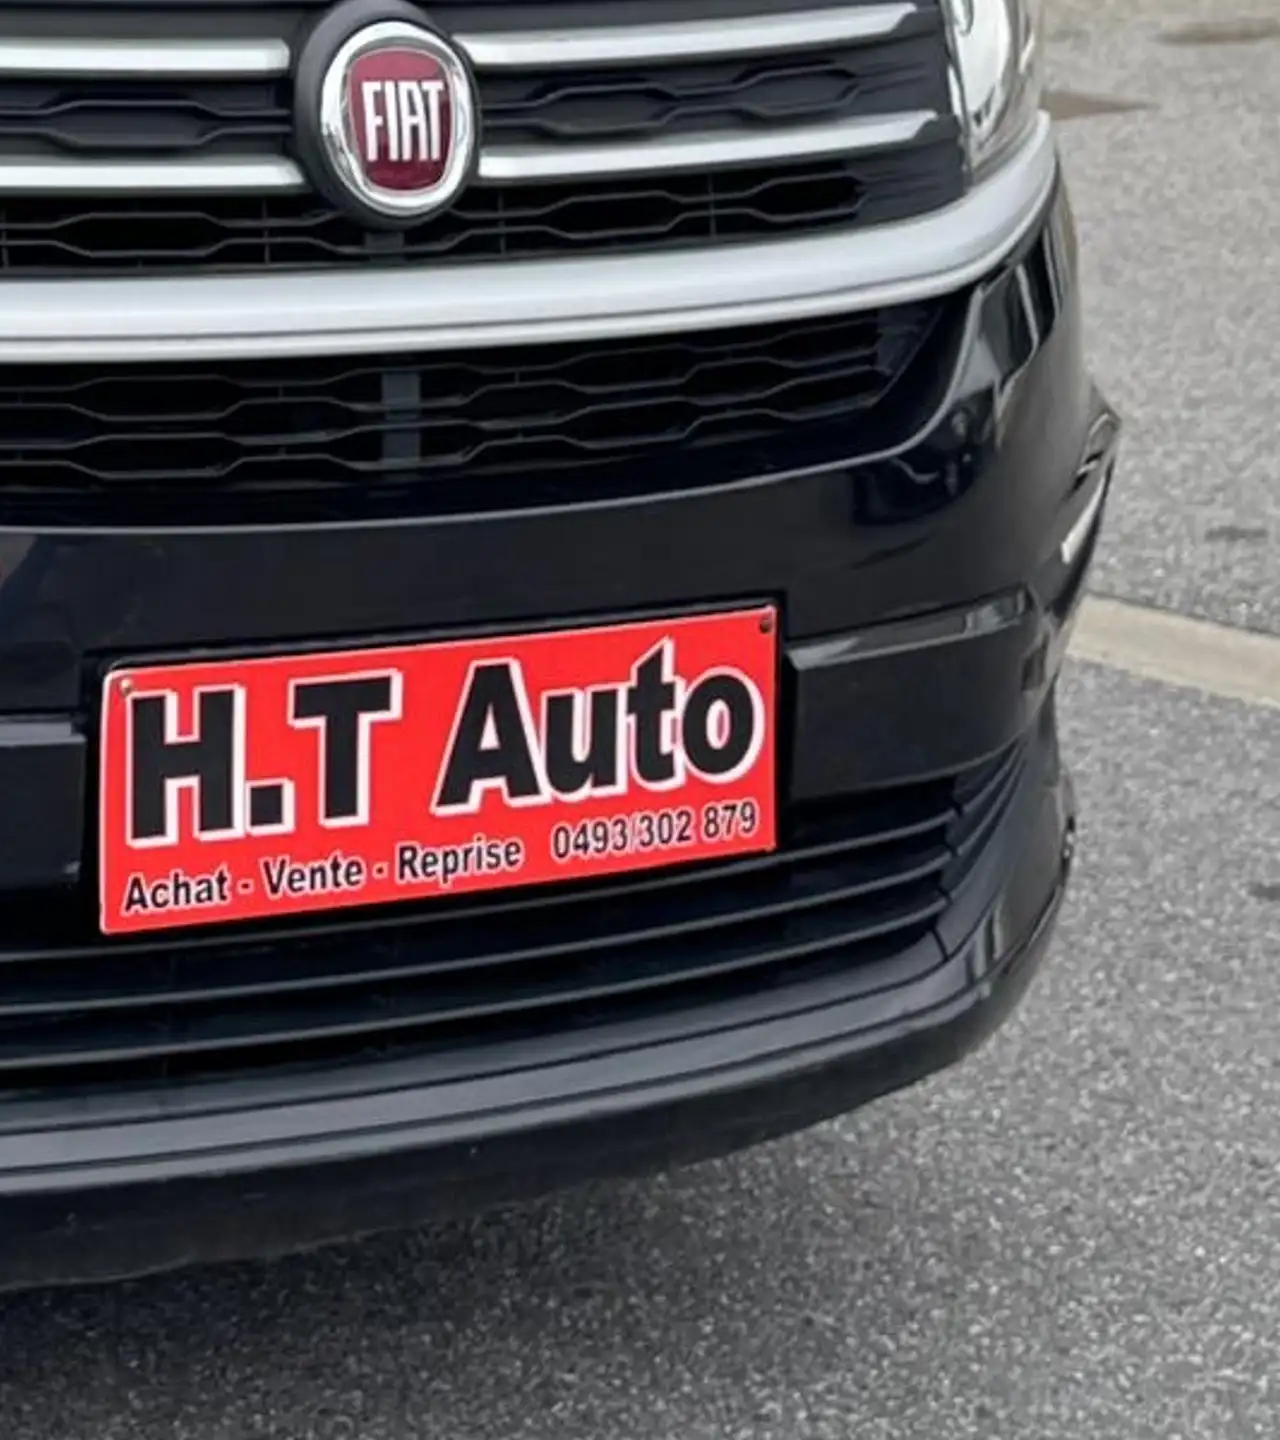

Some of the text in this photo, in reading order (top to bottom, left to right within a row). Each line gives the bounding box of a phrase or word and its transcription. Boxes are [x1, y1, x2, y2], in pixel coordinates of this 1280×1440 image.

[361, 79, 444, 162] FIAT
[127, 636, 765, 848] H.T Auto
[553, 801, 756, 860] 0493/302 879
[122, 872, 229, 915] Achat
[264, 857, 363, 898] Vente
[397, 837, 522, 887] Reprise
